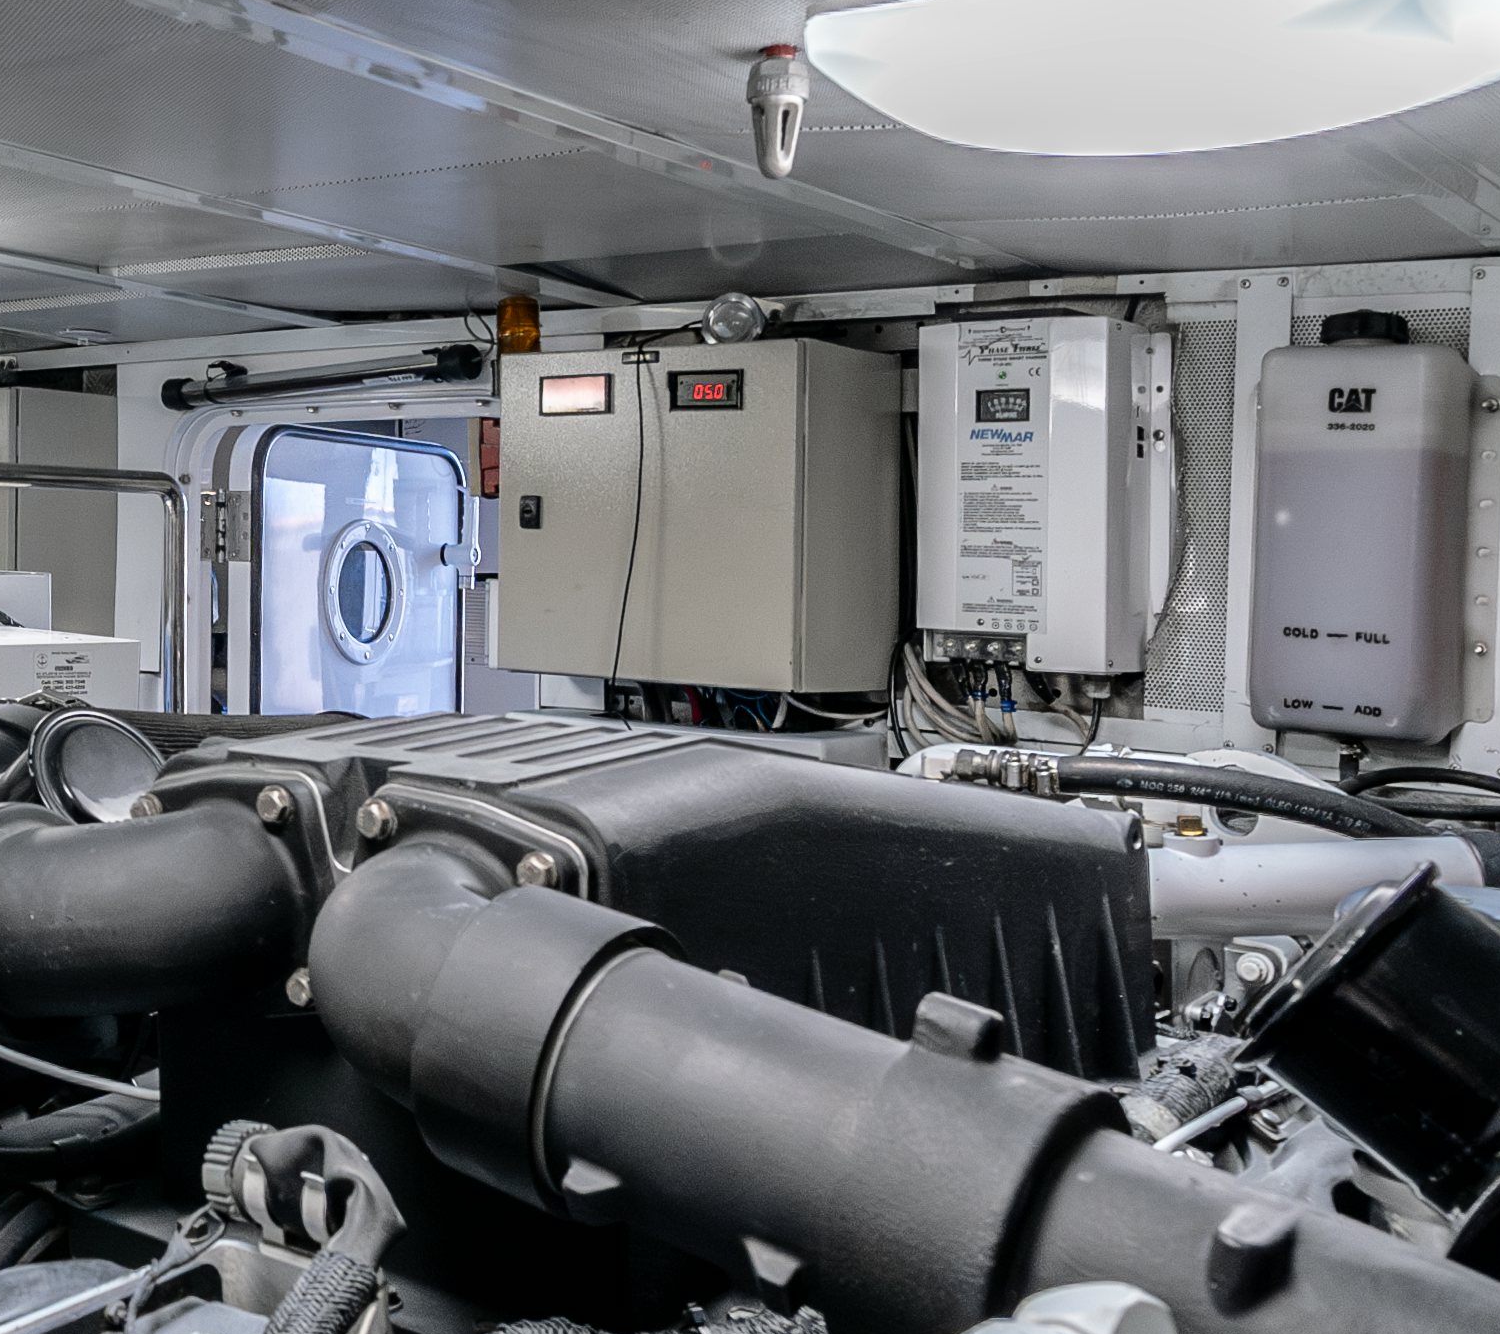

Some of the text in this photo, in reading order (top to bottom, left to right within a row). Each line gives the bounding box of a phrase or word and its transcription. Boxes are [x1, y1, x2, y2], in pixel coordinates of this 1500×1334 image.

[1328, 388, 1376, 414] CAT
[970, 428, 1034, 443] NEWMAR
[1283, 627, 1390, 644] COLD FULL
[1283, 698, 1382, 717] LOW ADD
